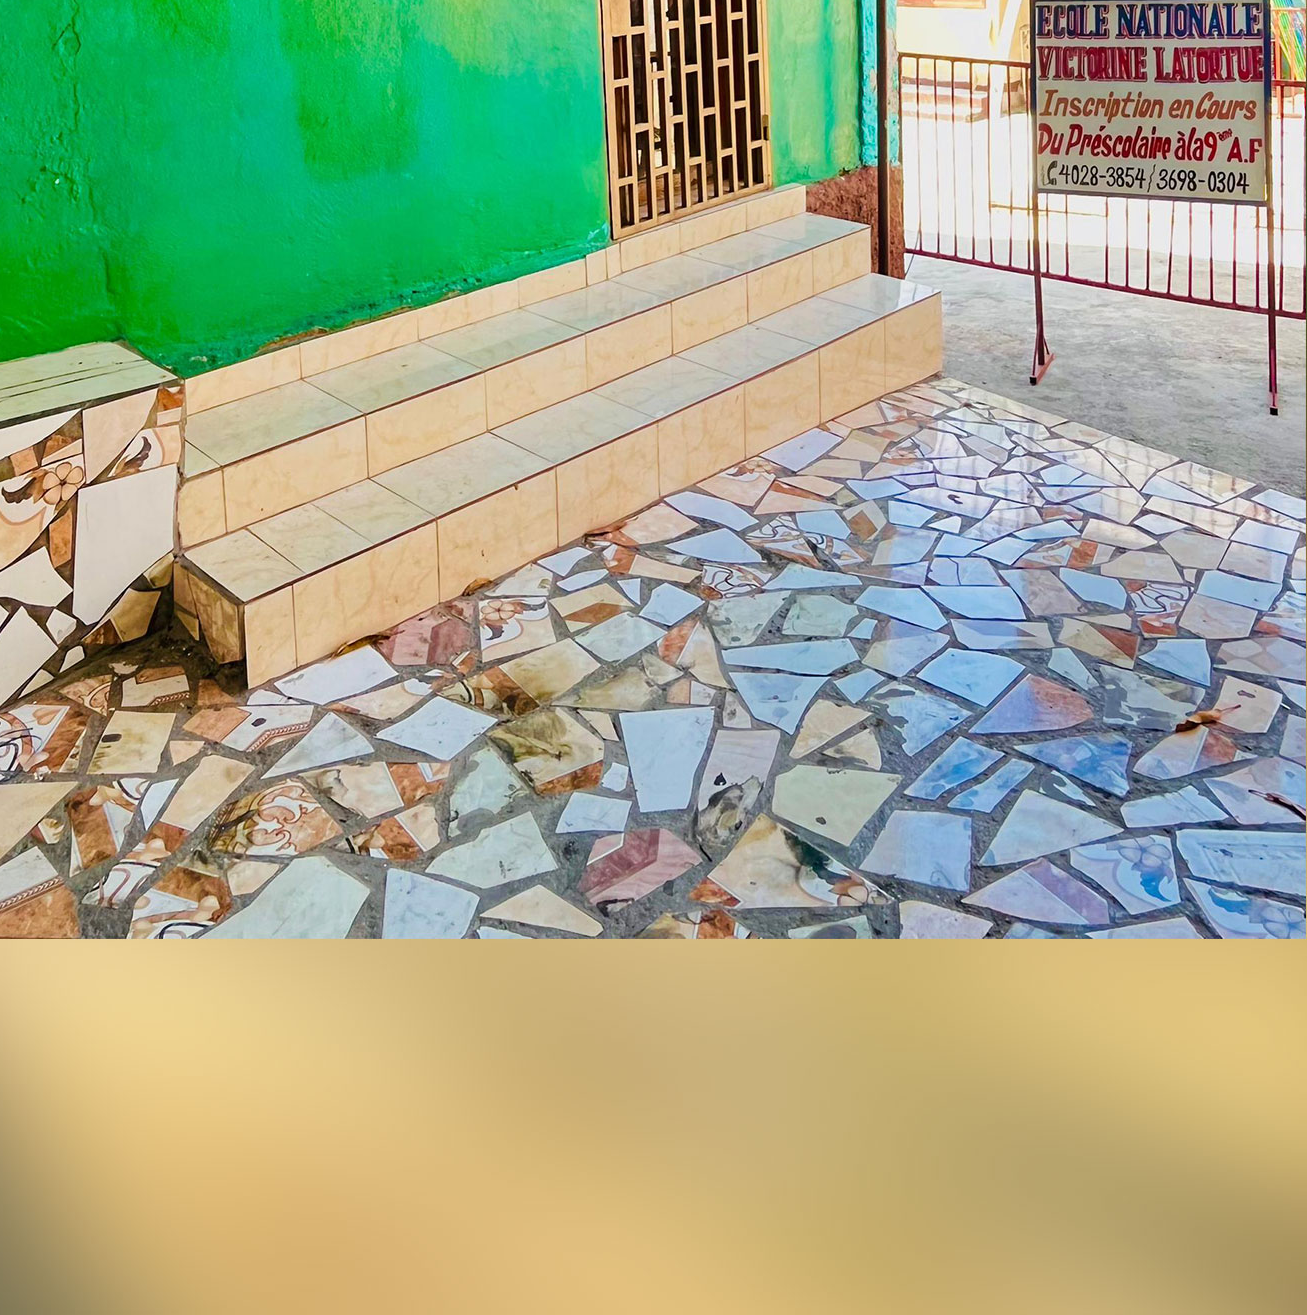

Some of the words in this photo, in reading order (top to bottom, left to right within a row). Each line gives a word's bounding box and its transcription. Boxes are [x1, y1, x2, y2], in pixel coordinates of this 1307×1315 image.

[1035, 4, 1109, 39] ECOLE
[1115, 2, 1263, 39] NATIONALE
[1037, 45, 1147, 82] VICTORINE
[1153, 45, 1264, 83] LATORTUE
[1039, 89, 1163, 123] Inscription
[1168, 99, 1192, 119] en
[1195, 91, 1257, 120] Cours
[1038, 123, 1064, 155] Du
[1065, 124, 1172, 160] Préscolaire
